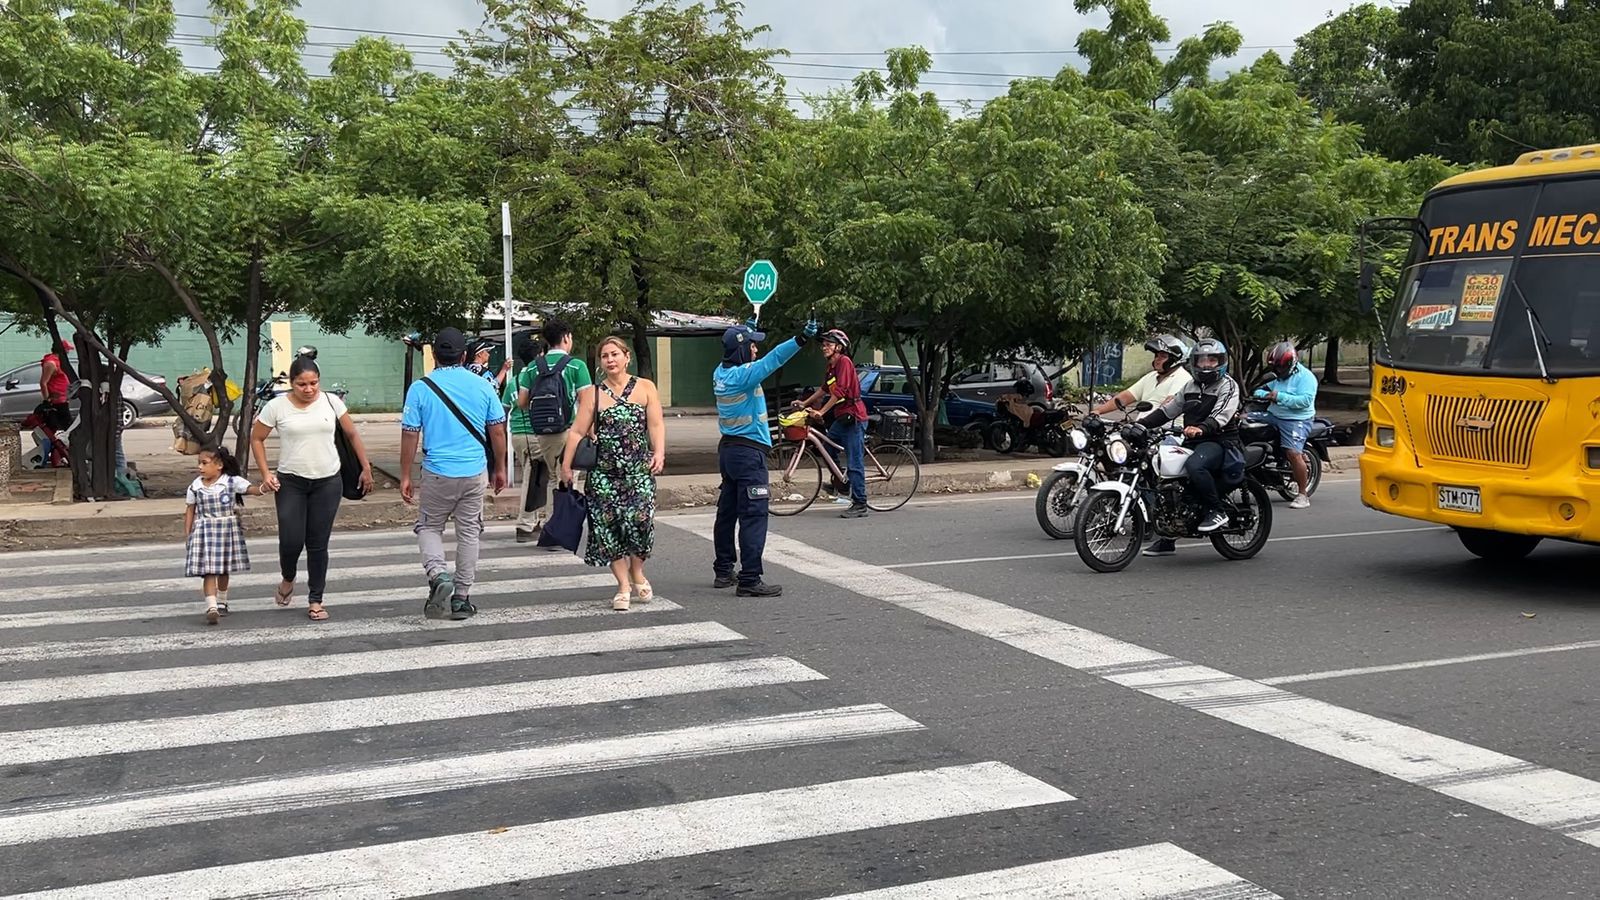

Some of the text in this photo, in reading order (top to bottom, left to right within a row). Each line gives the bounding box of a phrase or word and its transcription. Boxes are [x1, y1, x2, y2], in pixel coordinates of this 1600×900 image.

[1428, 213, 1600, 256] TRANS MEC
[748, 273, 771, 290] SIGA
[1468, 276, 1499, 285] C-30
